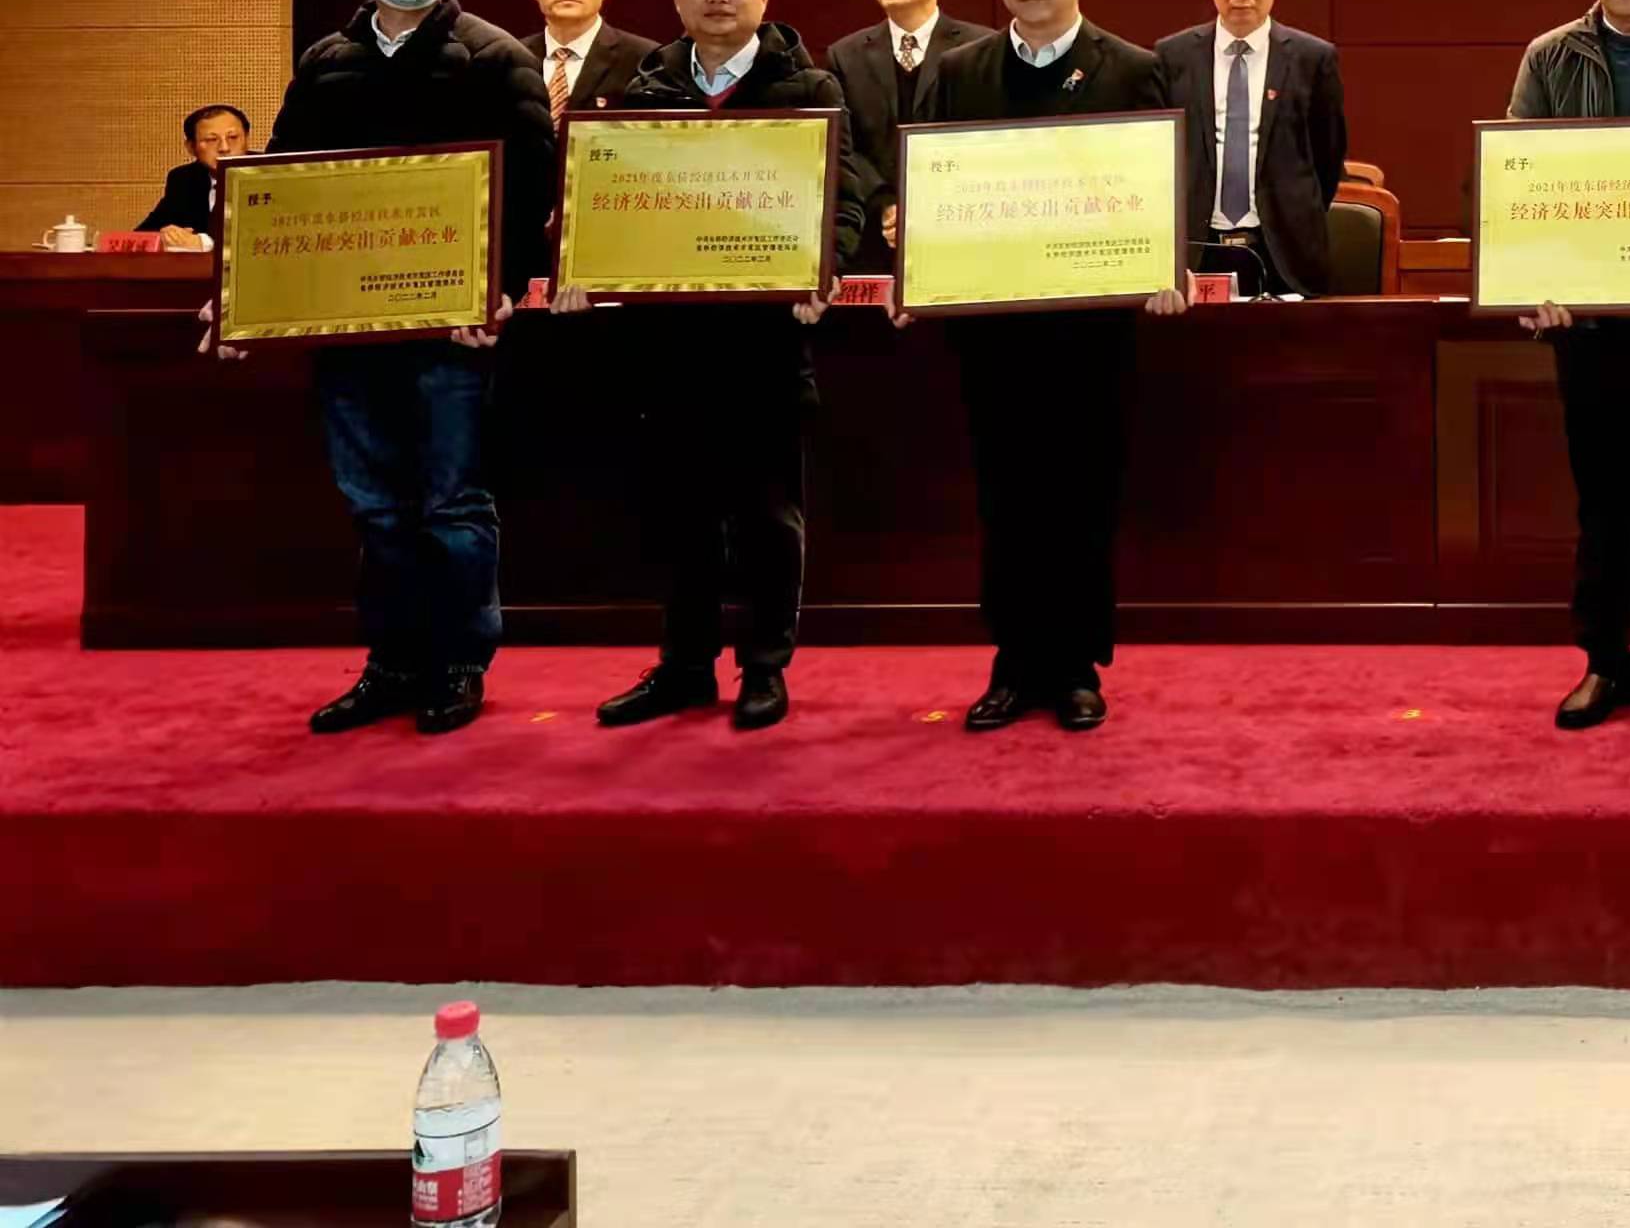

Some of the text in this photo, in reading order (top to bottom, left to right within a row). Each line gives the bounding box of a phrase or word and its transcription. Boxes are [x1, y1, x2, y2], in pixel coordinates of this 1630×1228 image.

[592, 190, 796, 212] 经济发展突出贡献企业
[935, 194, 1145, 223] 经济发展突出贡献企业
[252, 226, 458, 257] 经济发展突出贡献企业
